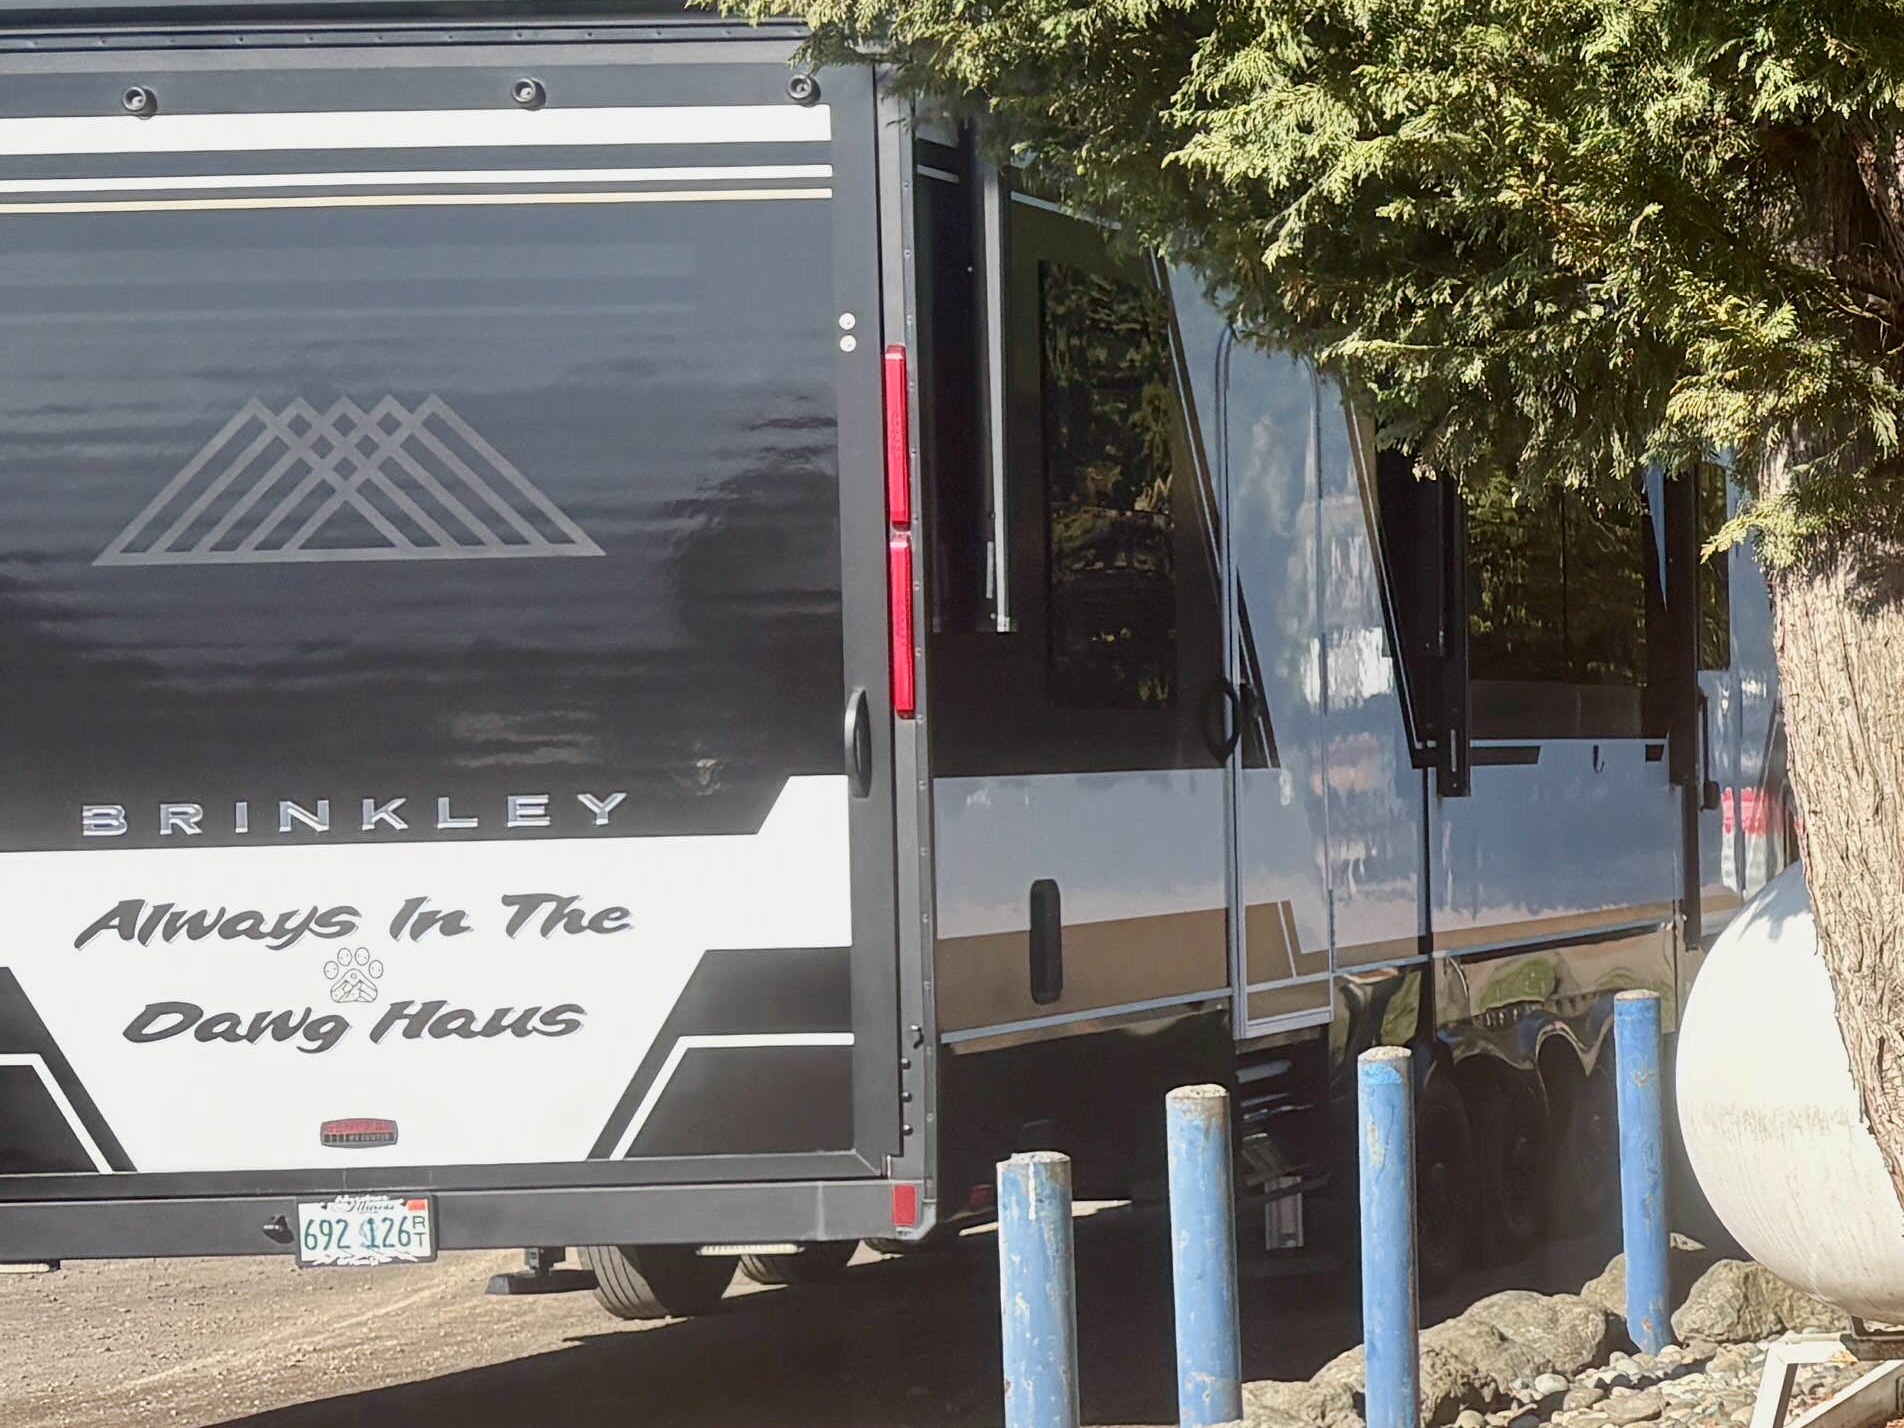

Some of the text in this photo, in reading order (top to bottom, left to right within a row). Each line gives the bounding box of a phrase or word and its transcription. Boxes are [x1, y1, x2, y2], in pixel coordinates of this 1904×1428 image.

[82, 792, 628, 837] BRINKLEY
[74, 892, 635, 951] Always In The
[122, 999, 589, 1055] Dawg Haus
[304, 1215, 412, 1251] 692 126
